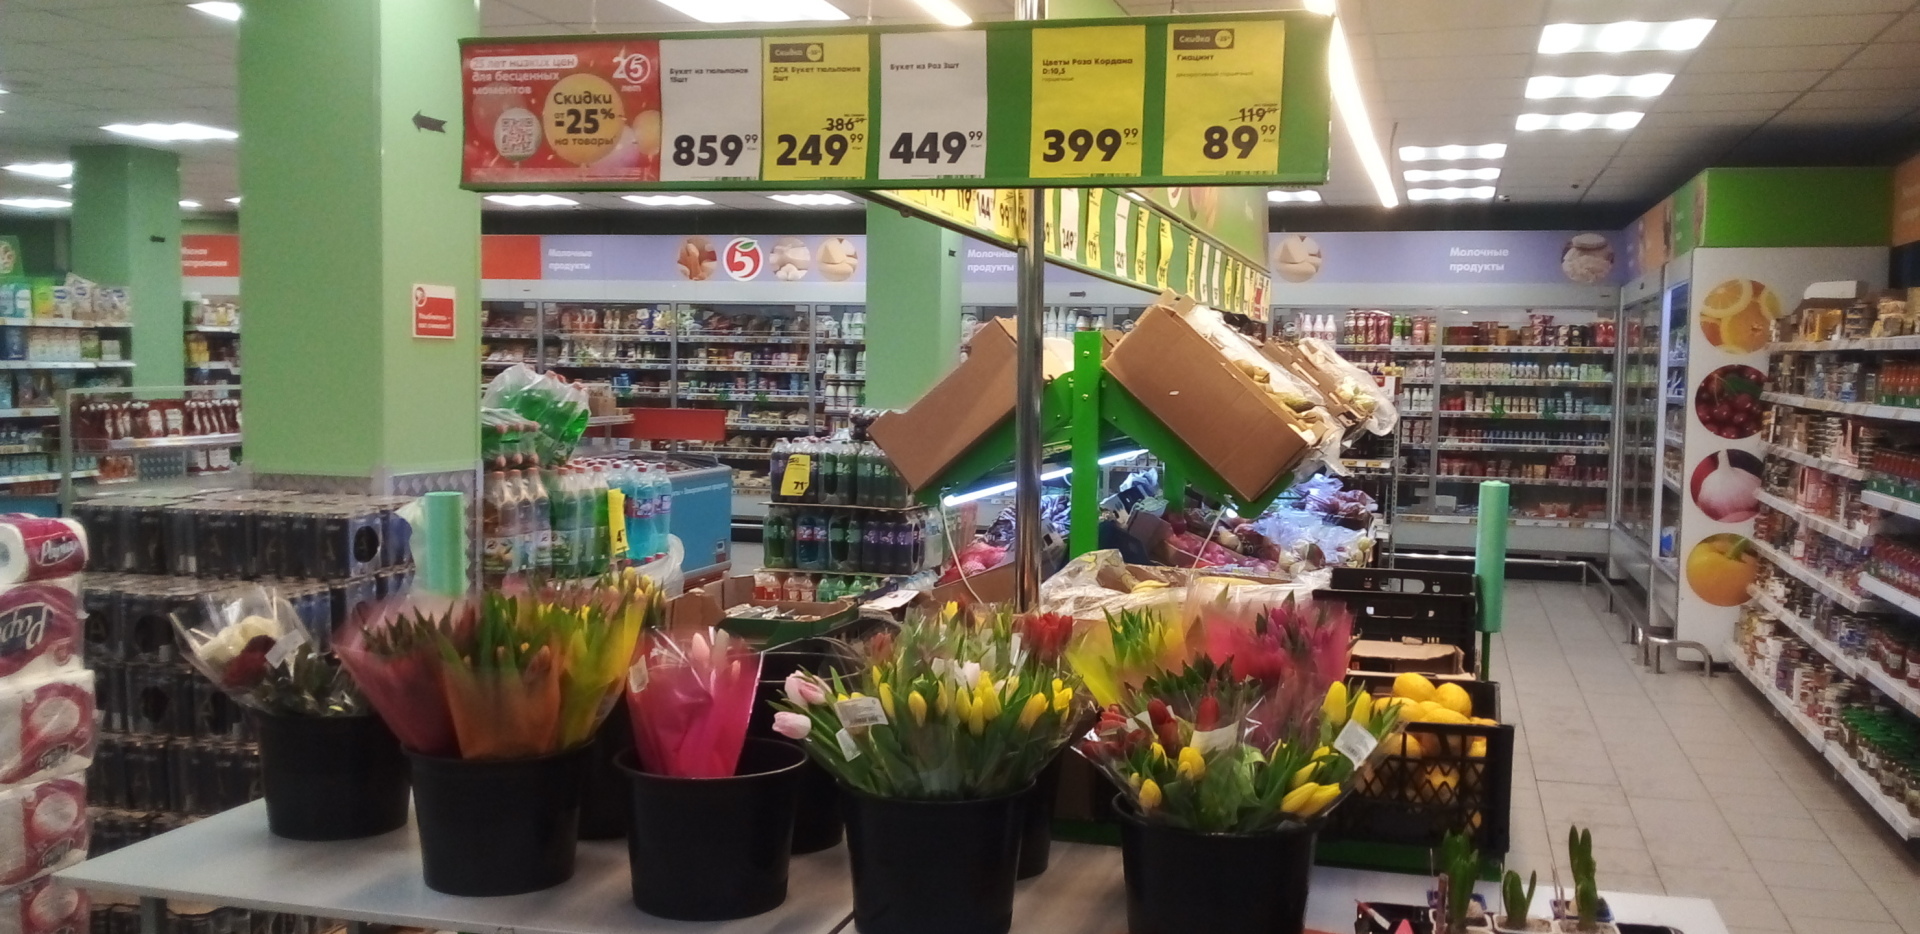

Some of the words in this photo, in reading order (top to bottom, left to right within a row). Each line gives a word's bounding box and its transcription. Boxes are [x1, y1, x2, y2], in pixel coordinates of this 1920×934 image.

[1179, 34, 1211, 44] Скидка
[774, 48, 804, 57] Скидка
[1177, 54, 1215, 62] Гиацинт
[509, 58, 550, 68] низких
[552, 57, 575, 68] цен
[890, 63, 914, 72] Букет
[927, 62, 942, 70] Роз
[943, 62, 960, 70] 3шт
[1042, 59, 1070, 67] Цветы
[1072, 58, 1092, 66] Роза
[1094, 57, 1134, 66] Кордана
[669, 68, 693, 76] Букет
[705, 67, 749, 75] тюльпанов
[773, 66, 788, 74] ДСК
[791, 66, 814, 74] Букет
[816, 66, 861, 74] тюльпанов
[472, 72, 493, 82] для
[496, 71, 560, 83] бесценных
[472, 86, 532, 95] моментов
[553, 90, 613, 105] Скидки
[1238, 107, 1266, 122] 119
[824, 117, 855, 131] 386
[554, 138, 568, 146] на
[571, 138, 614, 148] товары
[889, 131, 967, 164] 449
[968, 130, 983, 141] 99
[1042, 128, 1122, 163] 399
[1123, 127, 1139, 139] 99
[1203, 125, 1259, 160] 89
[1260, 124, 1277, 135] 99
[673, 134, 744, 166] 859
[744, 134, 758, 144] 99
[776, 133, 849, 166] 249
[849, 133, 864, 143] 99
[967, 248, 1018, 259] Молочные
[1449, 246, 1510, 257] Молочные
[967, 263, 1015, 273] продукты
[1449, 263, 1506, 274] продукты
[793, 481, 805, 491] 71
